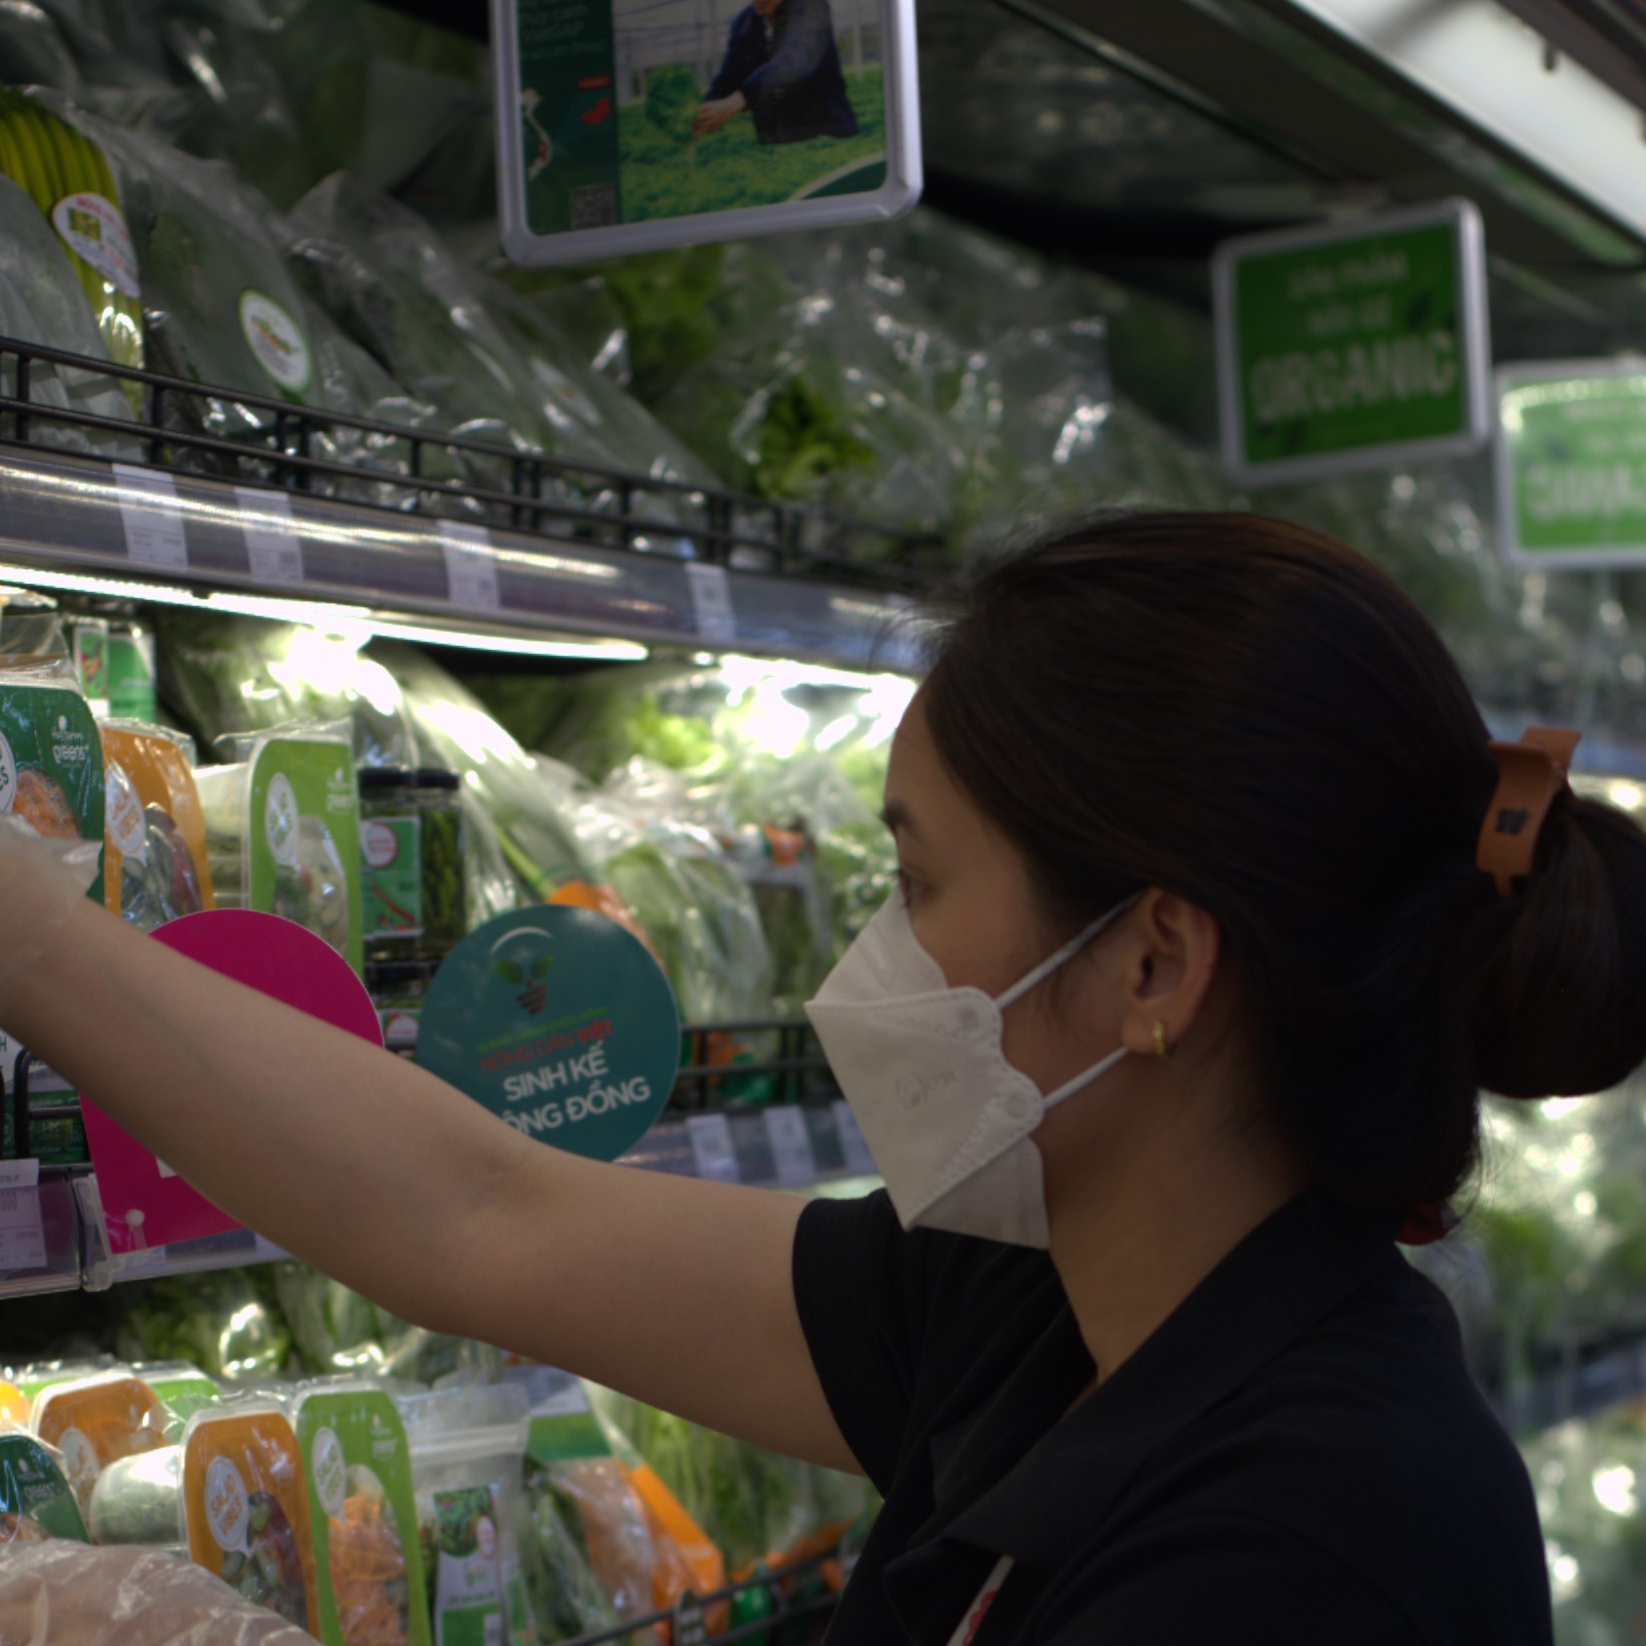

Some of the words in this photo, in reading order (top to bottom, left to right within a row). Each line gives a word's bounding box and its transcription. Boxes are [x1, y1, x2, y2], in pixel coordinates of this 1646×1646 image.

[1251, 327, 1457, 424] ORGANIC
[504, 1061, 568, 1101] SINH
[569, 1039, 609, 1081] KẾ
